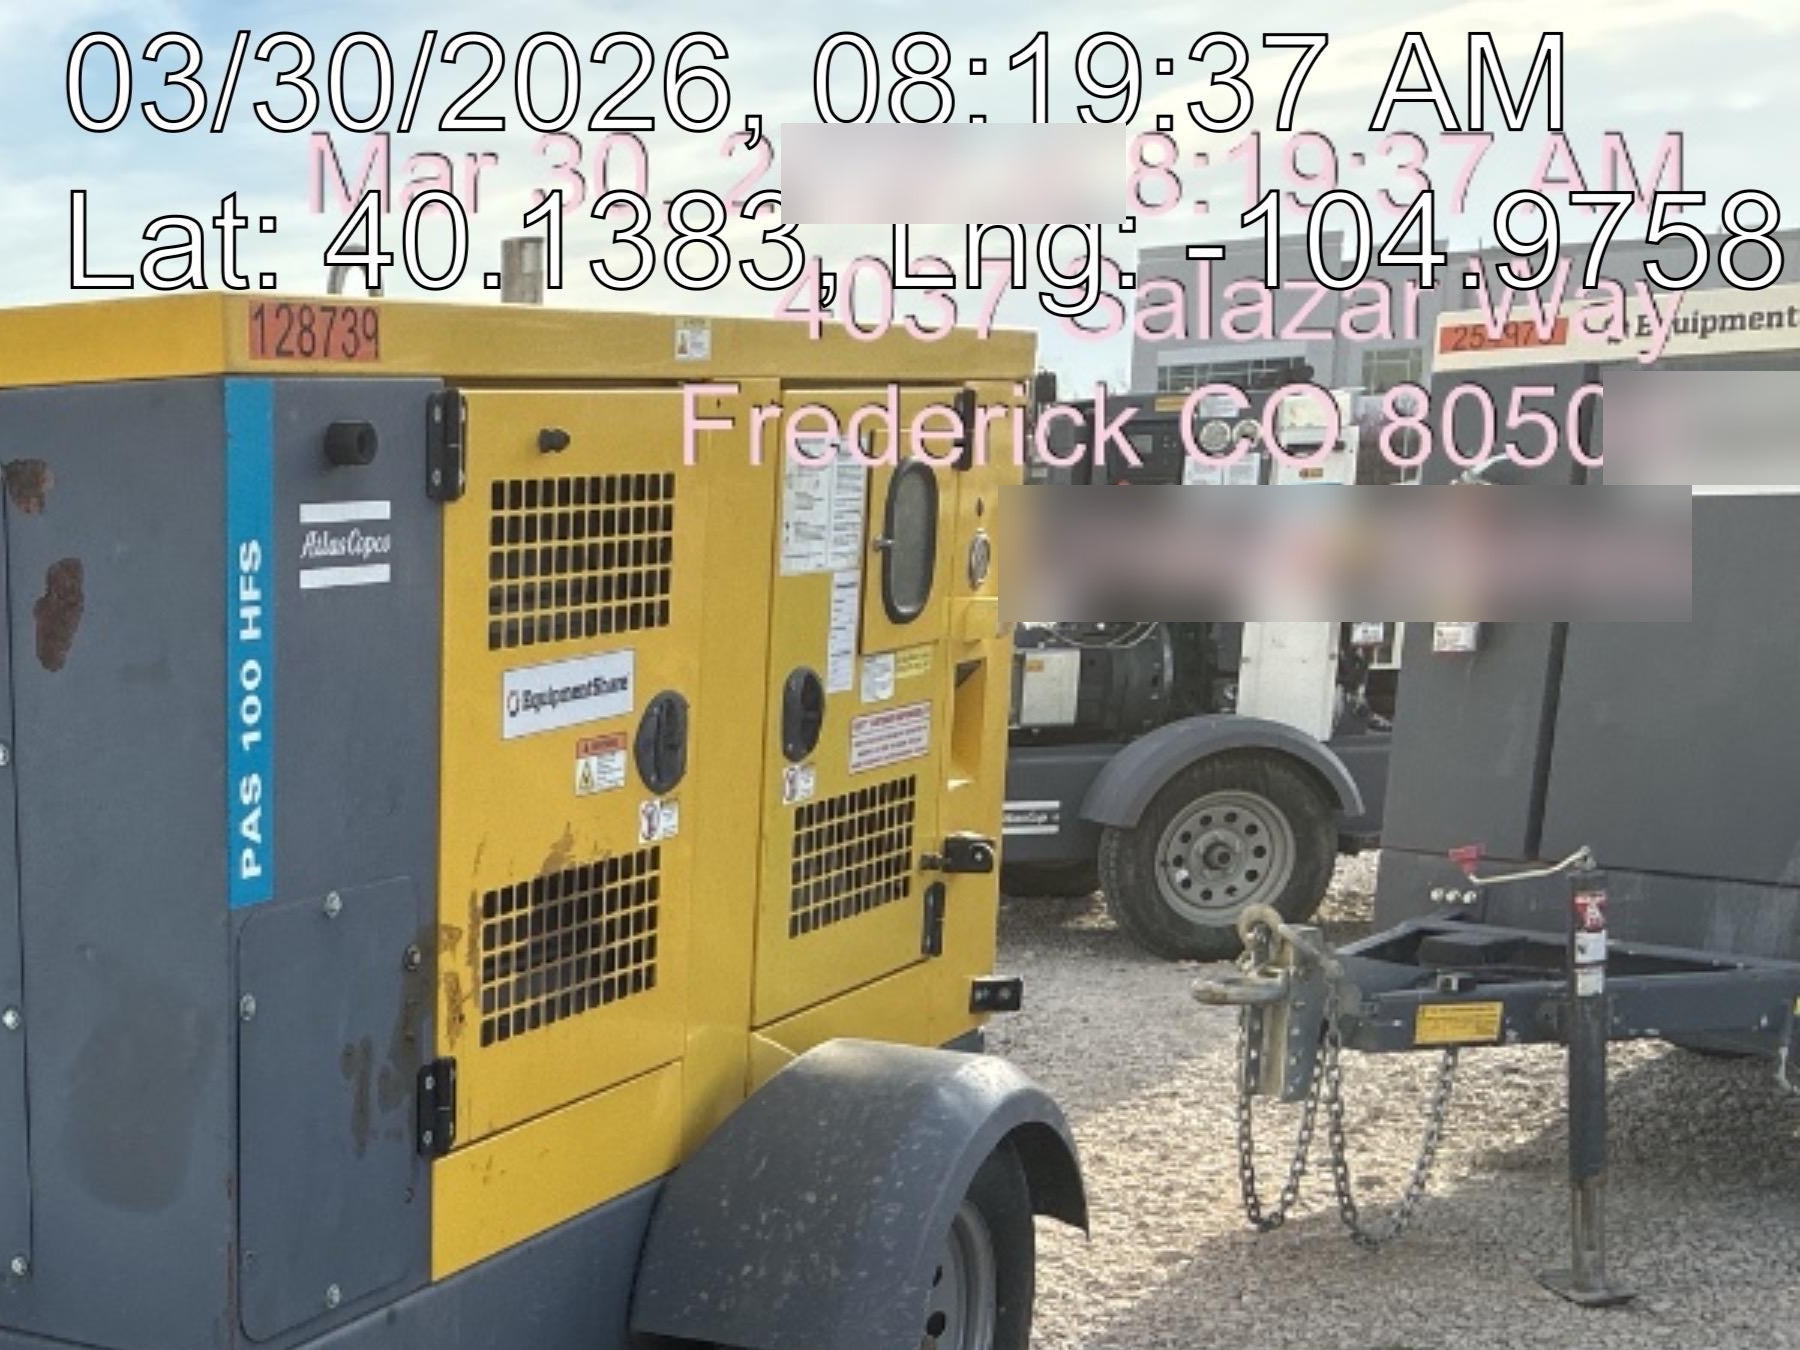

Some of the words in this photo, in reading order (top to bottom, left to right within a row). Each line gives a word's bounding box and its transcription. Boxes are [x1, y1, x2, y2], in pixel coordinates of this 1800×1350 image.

[253, 302, 379, 360] 128739
[1634, 305, 1800, 341] Euipment
[239, 537, 263, 641] HFS
[239, 658, 263, 751] 100
[239, 772, 263, 880] PAS
